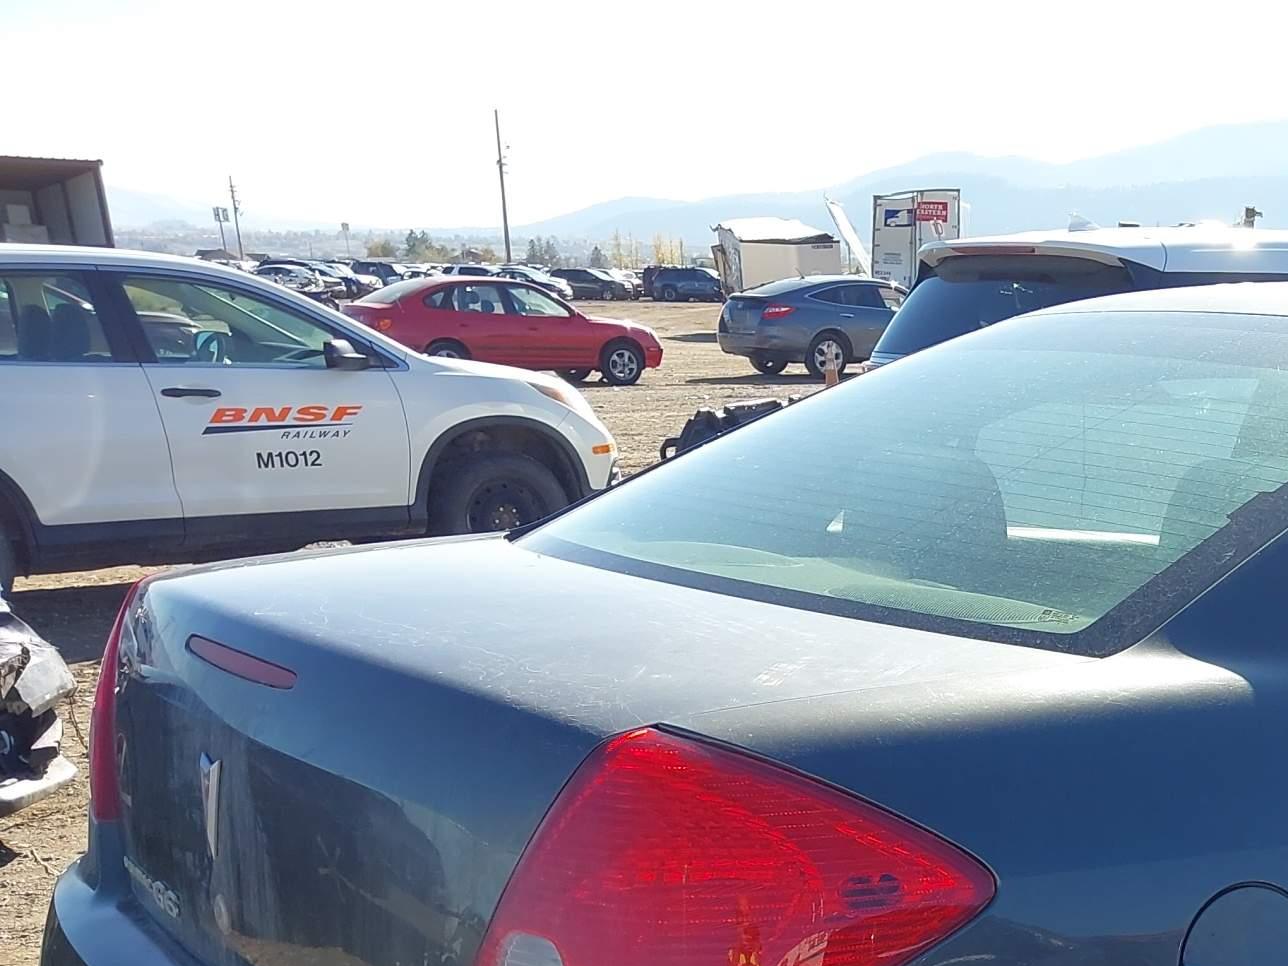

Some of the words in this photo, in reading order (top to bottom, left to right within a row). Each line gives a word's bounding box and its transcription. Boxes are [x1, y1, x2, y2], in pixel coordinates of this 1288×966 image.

[209, 405, 363, 424] BNSF
[280, 430, 351, 440] RAILWAY
[256, 450, 323, 469] M1012
[152, 880, 181, 918] G6
